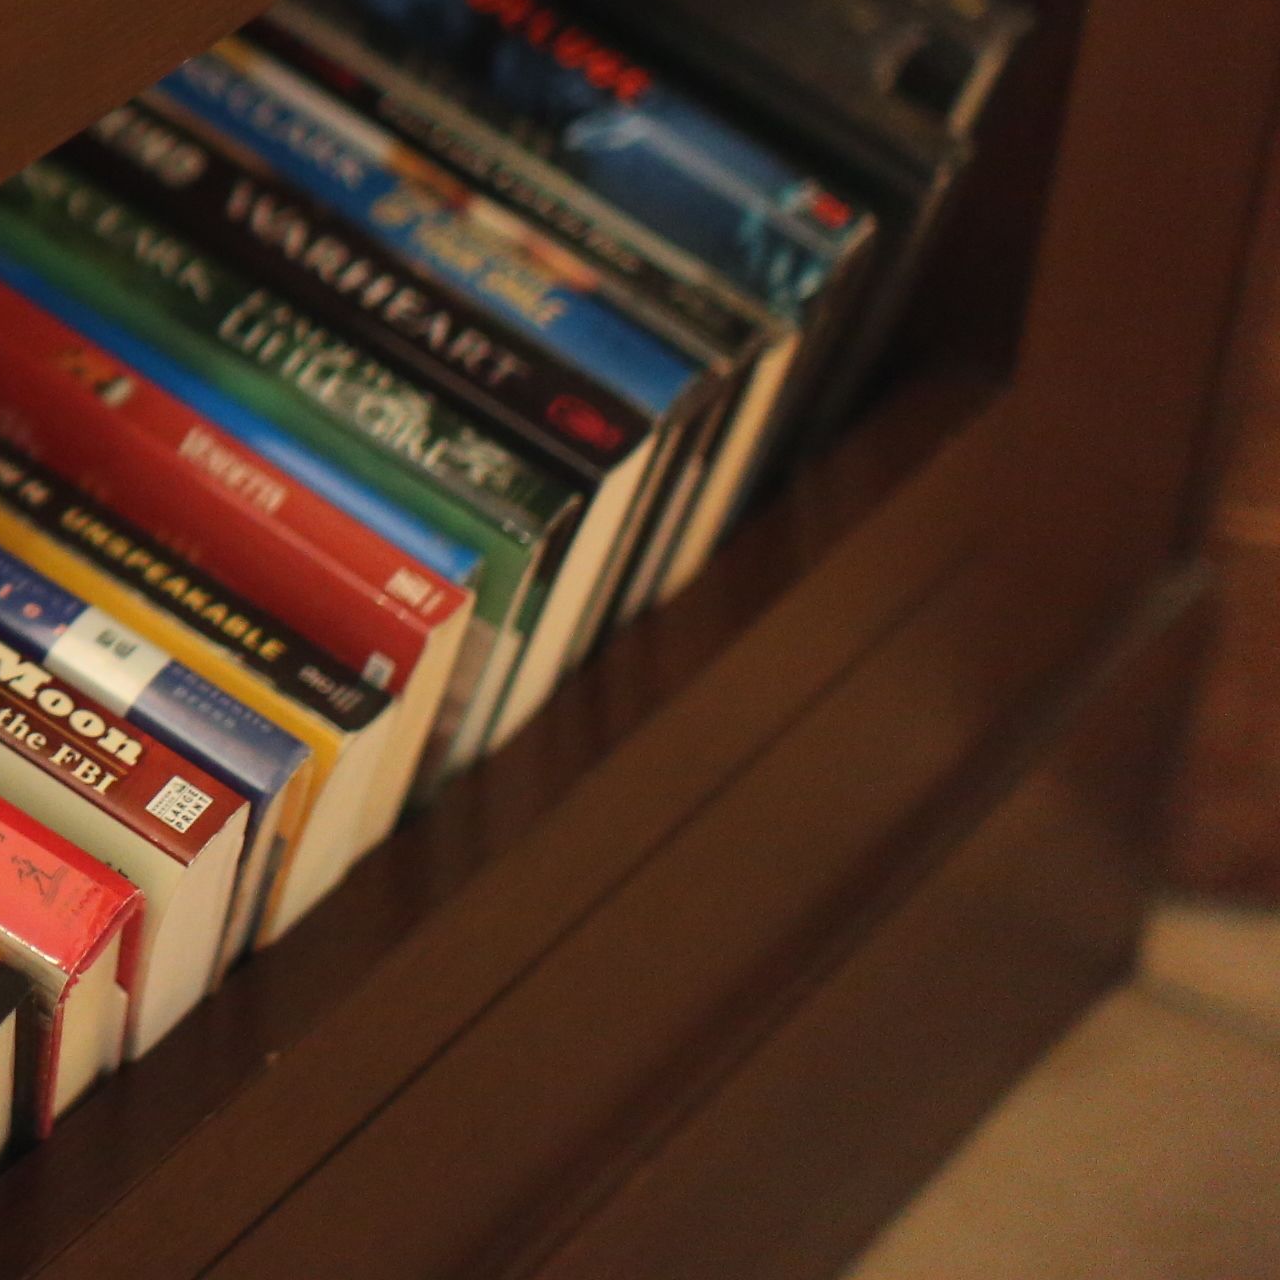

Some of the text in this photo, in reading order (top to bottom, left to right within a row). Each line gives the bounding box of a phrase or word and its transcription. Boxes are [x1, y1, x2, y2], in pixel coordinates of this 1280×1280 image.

[227, 180, 532, 391] WARHEART
[60, 506, 289, 666] UNSPEAKABLE
[47, 741, 119, 797] FBI
[163, 789, 198, 831] LARGE
[173, 793, 214, 834] PRINT
